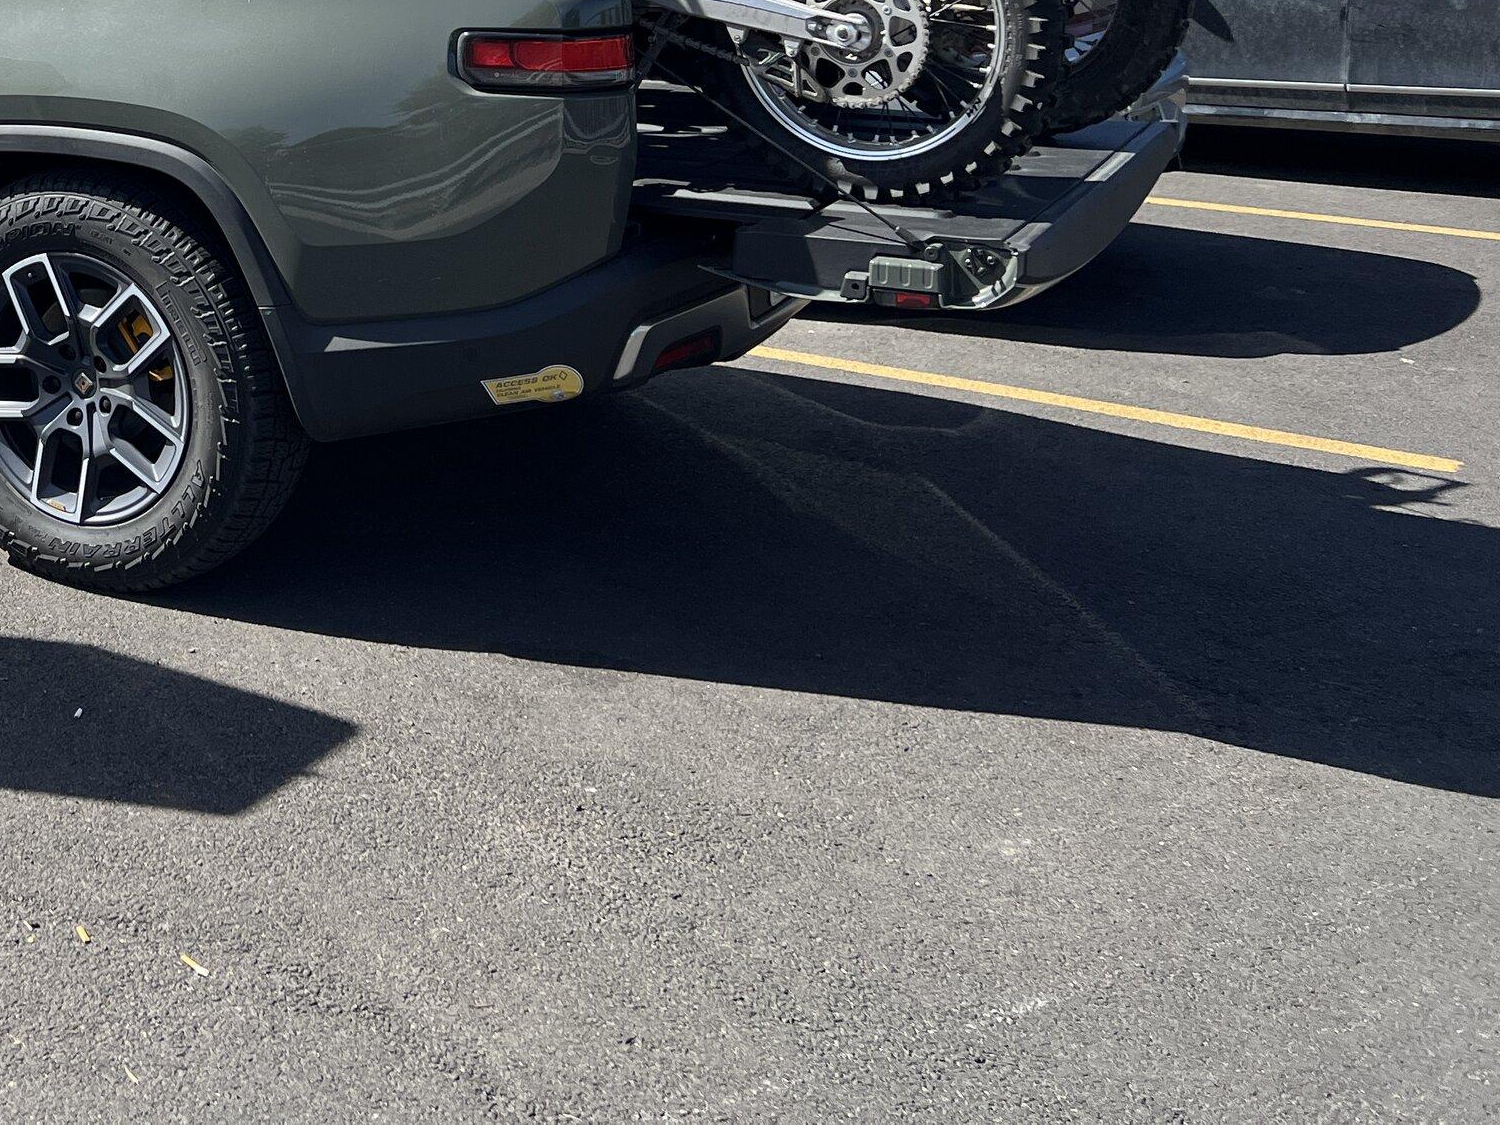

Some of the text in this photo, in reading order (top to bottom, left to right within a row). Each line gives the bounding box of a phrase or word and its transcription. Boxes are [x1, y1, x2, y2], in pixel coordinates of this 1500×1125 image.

[496, 374, 557, 388] ACCESS OK
[49, 516, 177, 558] TERRAIN
